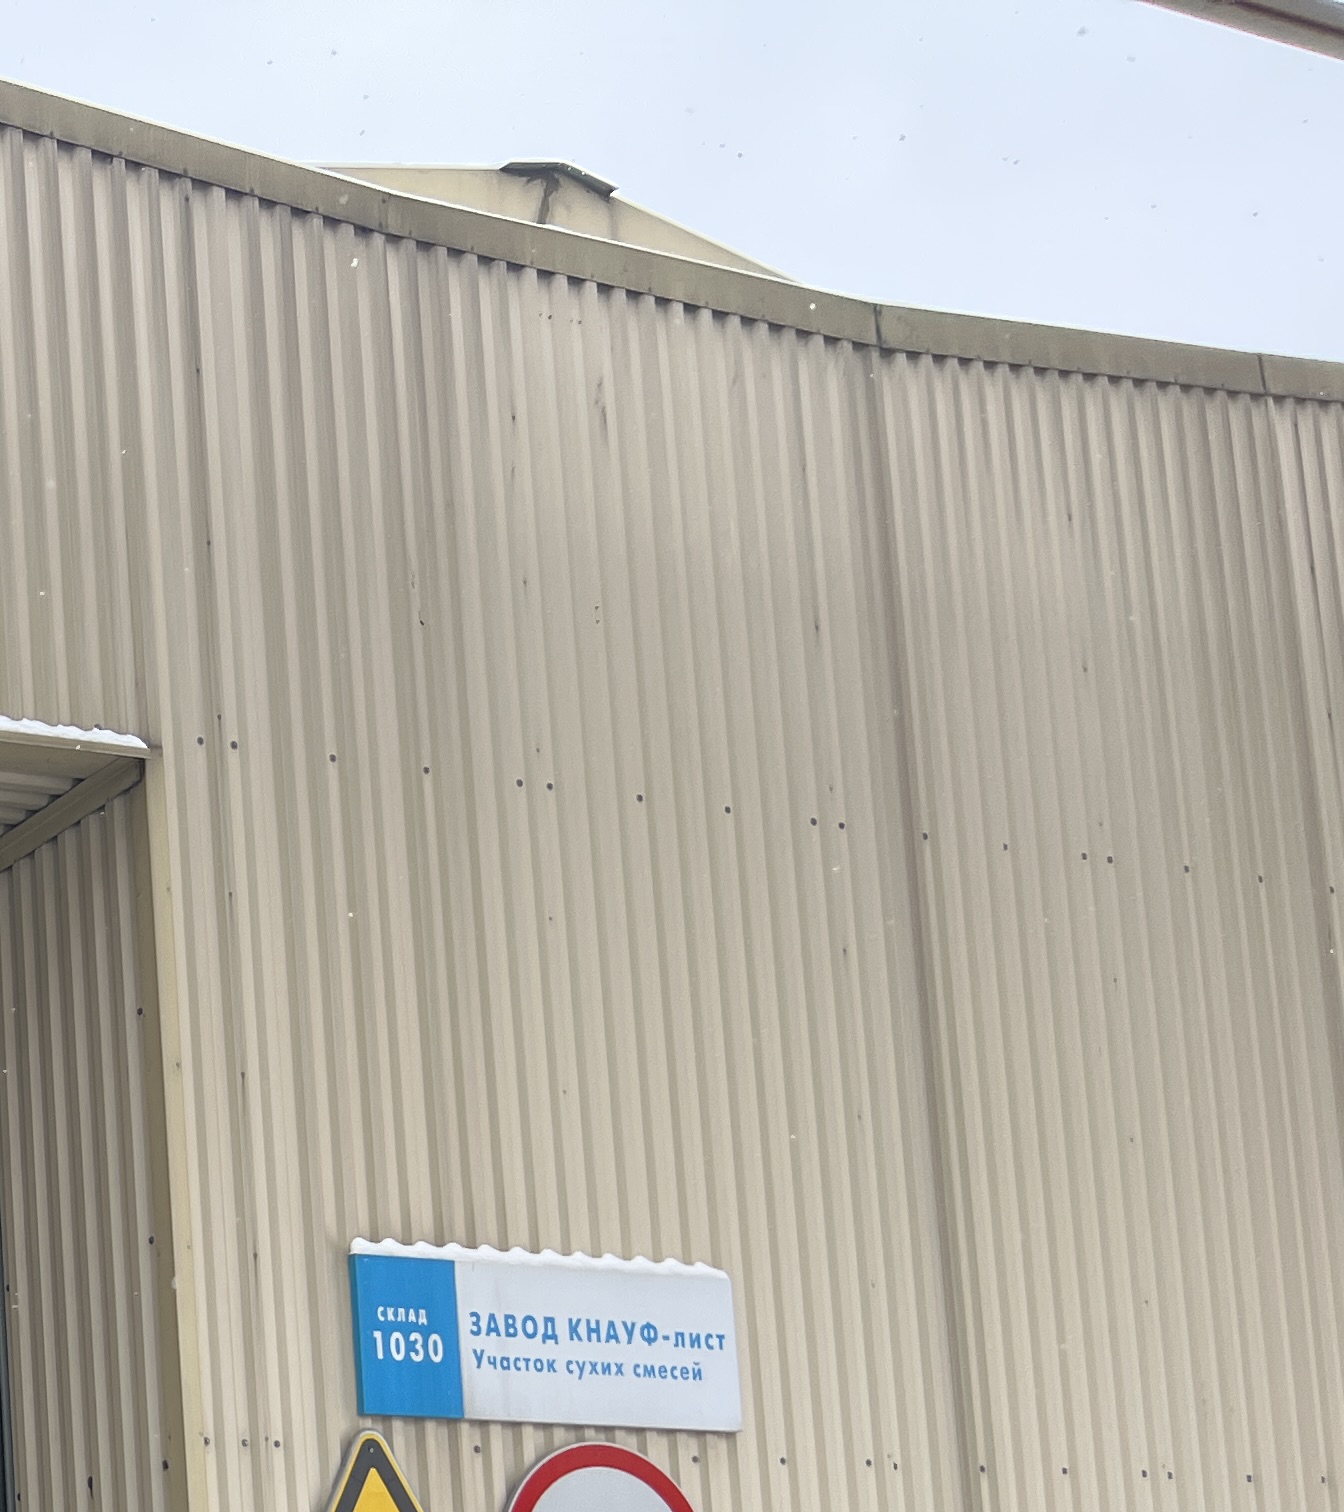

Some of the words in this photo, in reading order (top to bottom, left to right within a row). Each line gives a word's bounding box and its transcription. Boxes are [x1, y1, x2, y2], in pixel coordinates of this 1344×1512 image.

[469, 1311, 559, 1345] ЗАВОД
[373, 1330, 444, 1363] 1030
[472, 1348, 557, 1373] Участок
[566, 1359, 624, 1380] сухих
[633, 1361, 703, 1381] смесей
